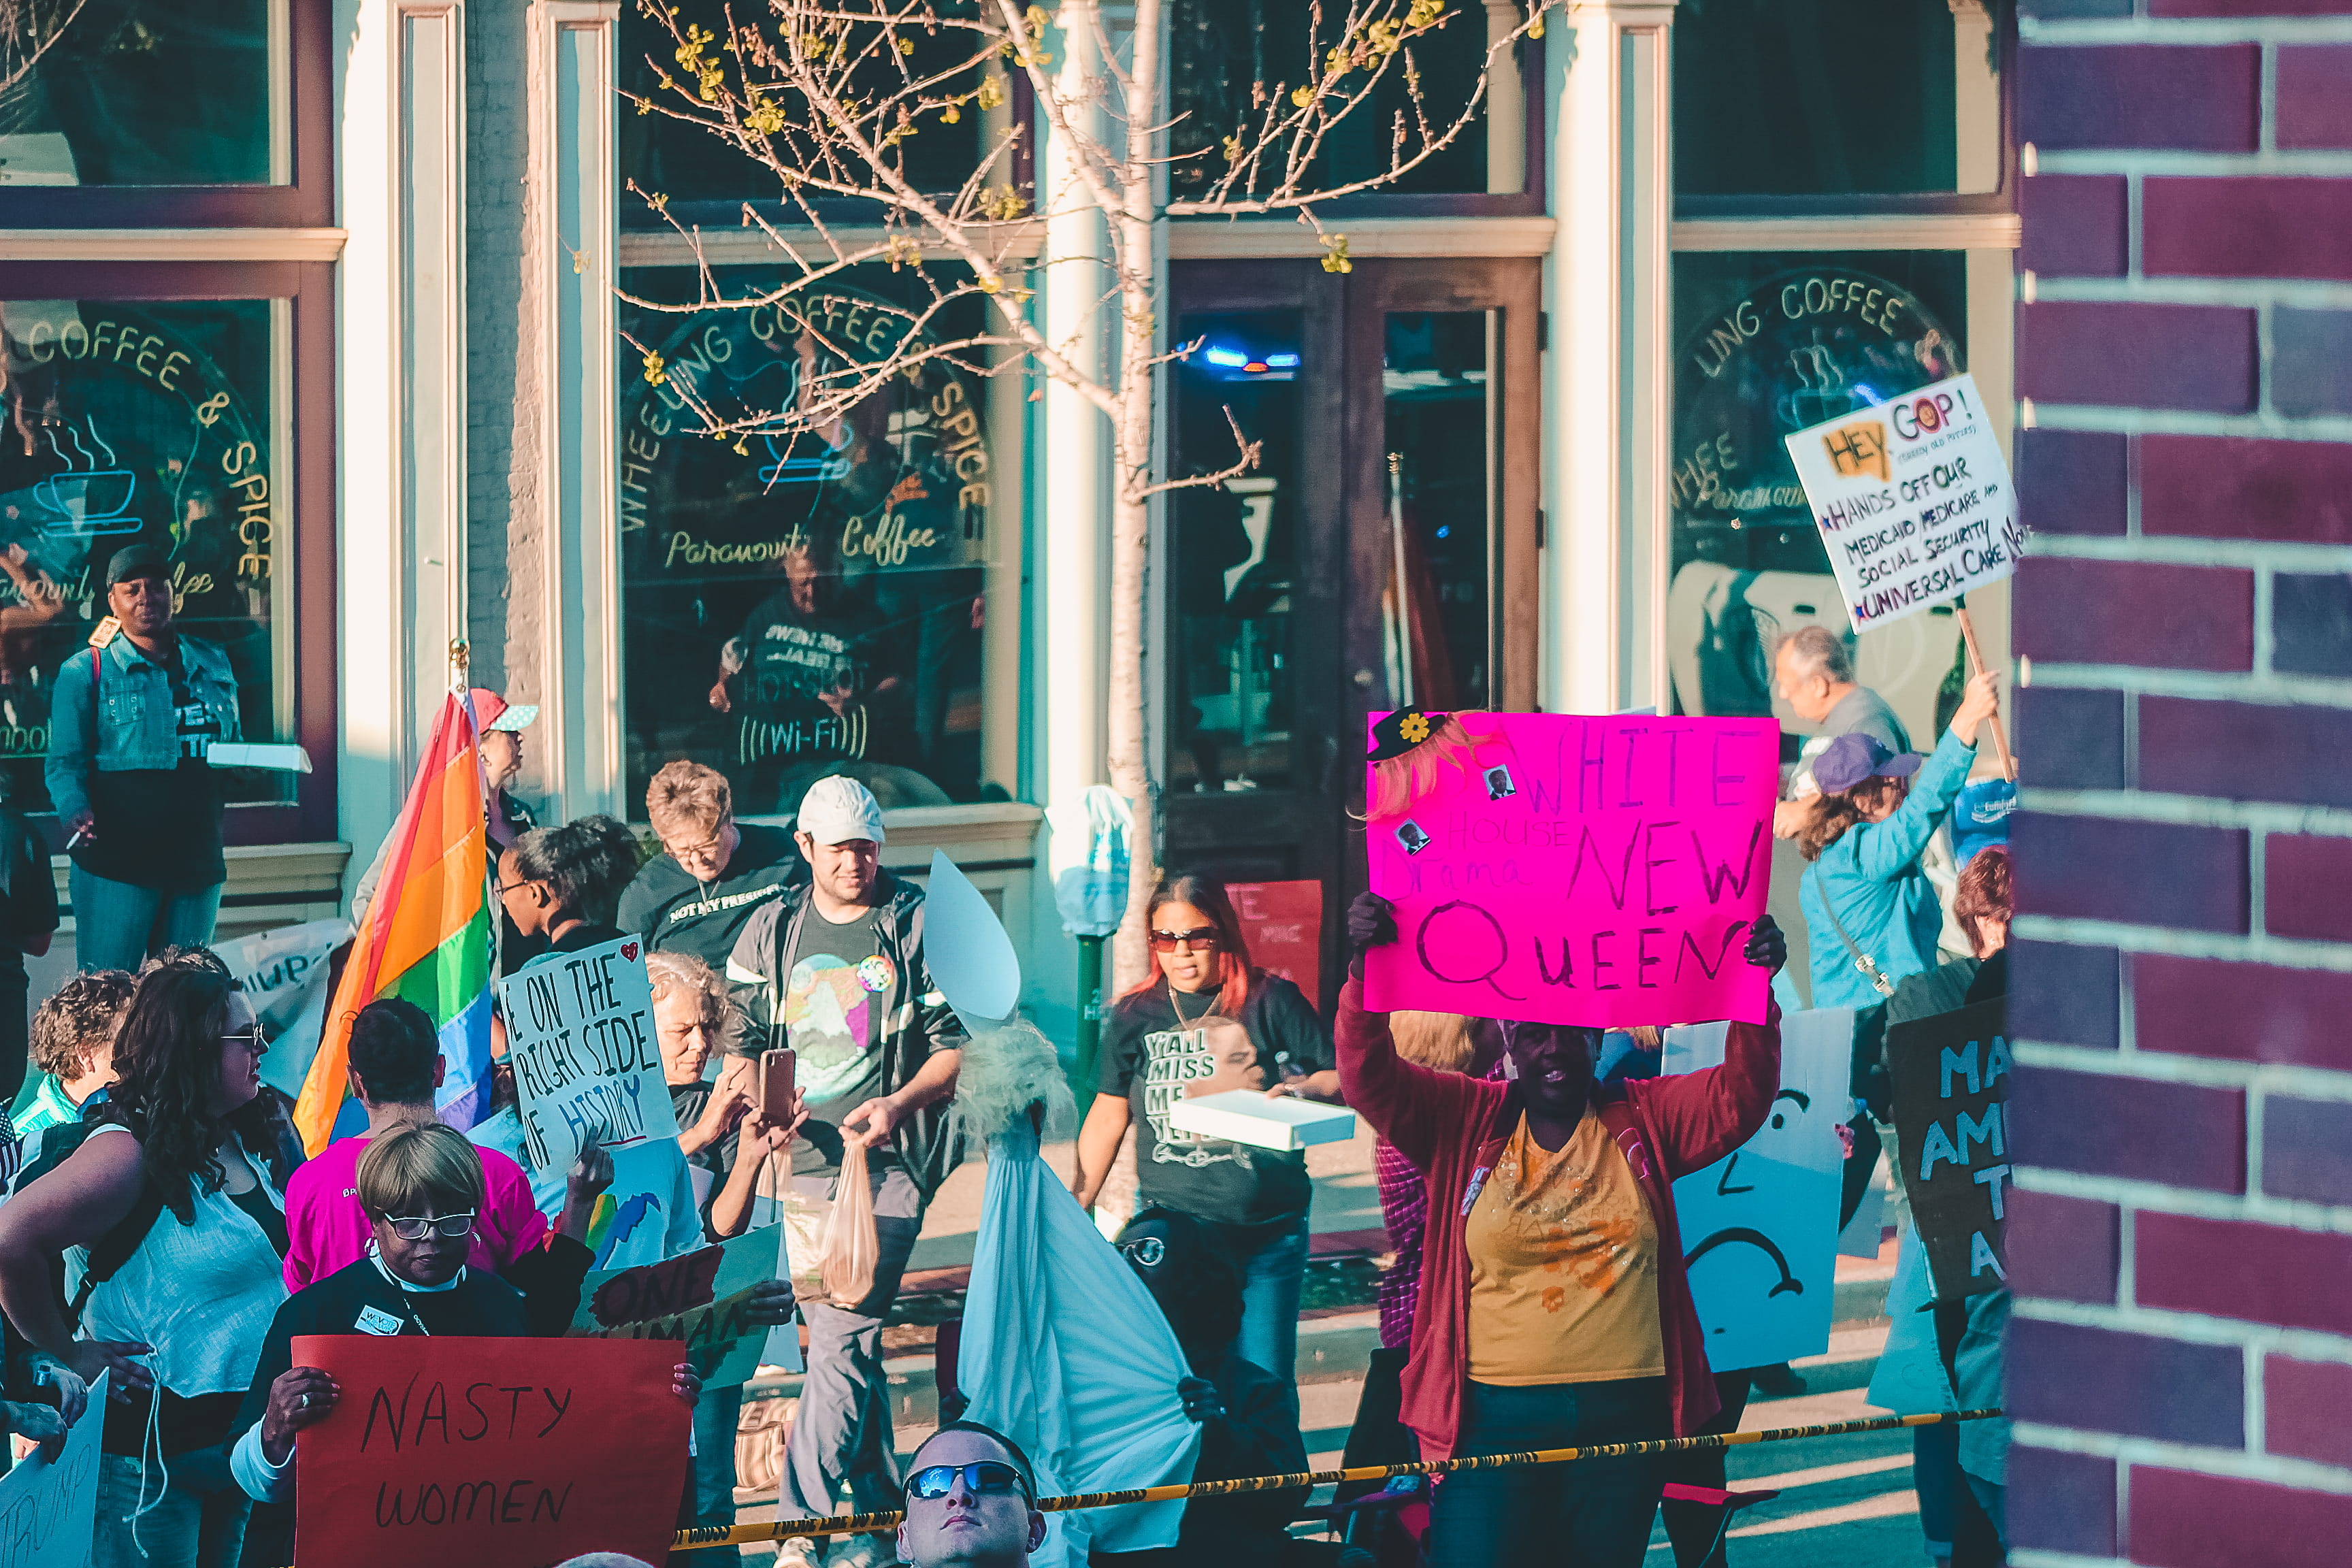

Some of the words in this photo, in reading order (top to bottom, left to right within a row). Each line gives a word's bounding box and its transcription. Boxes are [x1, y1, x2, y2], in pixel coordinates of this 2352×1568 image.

[1781, 278, 1904, 336] COFFEE
[749, 295, 893, 354] COFFEE
[932, 382, 991, 510] SPICE
[29, 321, 190, 391] COFFEE
[197, 392, 230, 426] &
[223, 442, 272, 579] SPICE
[1827, 489, 1896, 531] HANDS
[1901, 474, 1931, 502] OFF
[1931, 457, 1972, 490] OUR
[1984, 484, 1998, 497] AND
[666, 523, 808, 568] Paramount
[843, 514, 936, 566] Coffee
[1857, 546, 1918, 588] SOCIAL
[1923, 519, 1991, 560] SECURITY
[1862, 561, 1965, 619] UNIVERSAL
[1963, 542, 2006, 576] CARE
[1499, 718, 1763, 815] WHITE
[1448, 811, 1571, 851] HOUSE
[1568, 819, 1765, 915] NEW
[1382, 839, 1532, 900] Drama
[670, 902, 697, 924] NOT
[697, 898, 721, 916] MY
[1416, 900, 1748, 1001] QUEEN
[527, 972, 564, 1034] ON
[564, 952, 621, 1019] THE
[516, 1028, 585, 1101] RIGHT
[583, 1010, 657, 1077] SIDE
[1145, 1056, 1215, 1084] MISS
[523, 1109, 551, 1171] OF
[558, 1074, 644, 1156] HISTORY
[600, 1254, 715, 1327] ONE
[360, 1371, 572, 1453] NASTY
[376, 1479, 573, 1528] WOMEN
